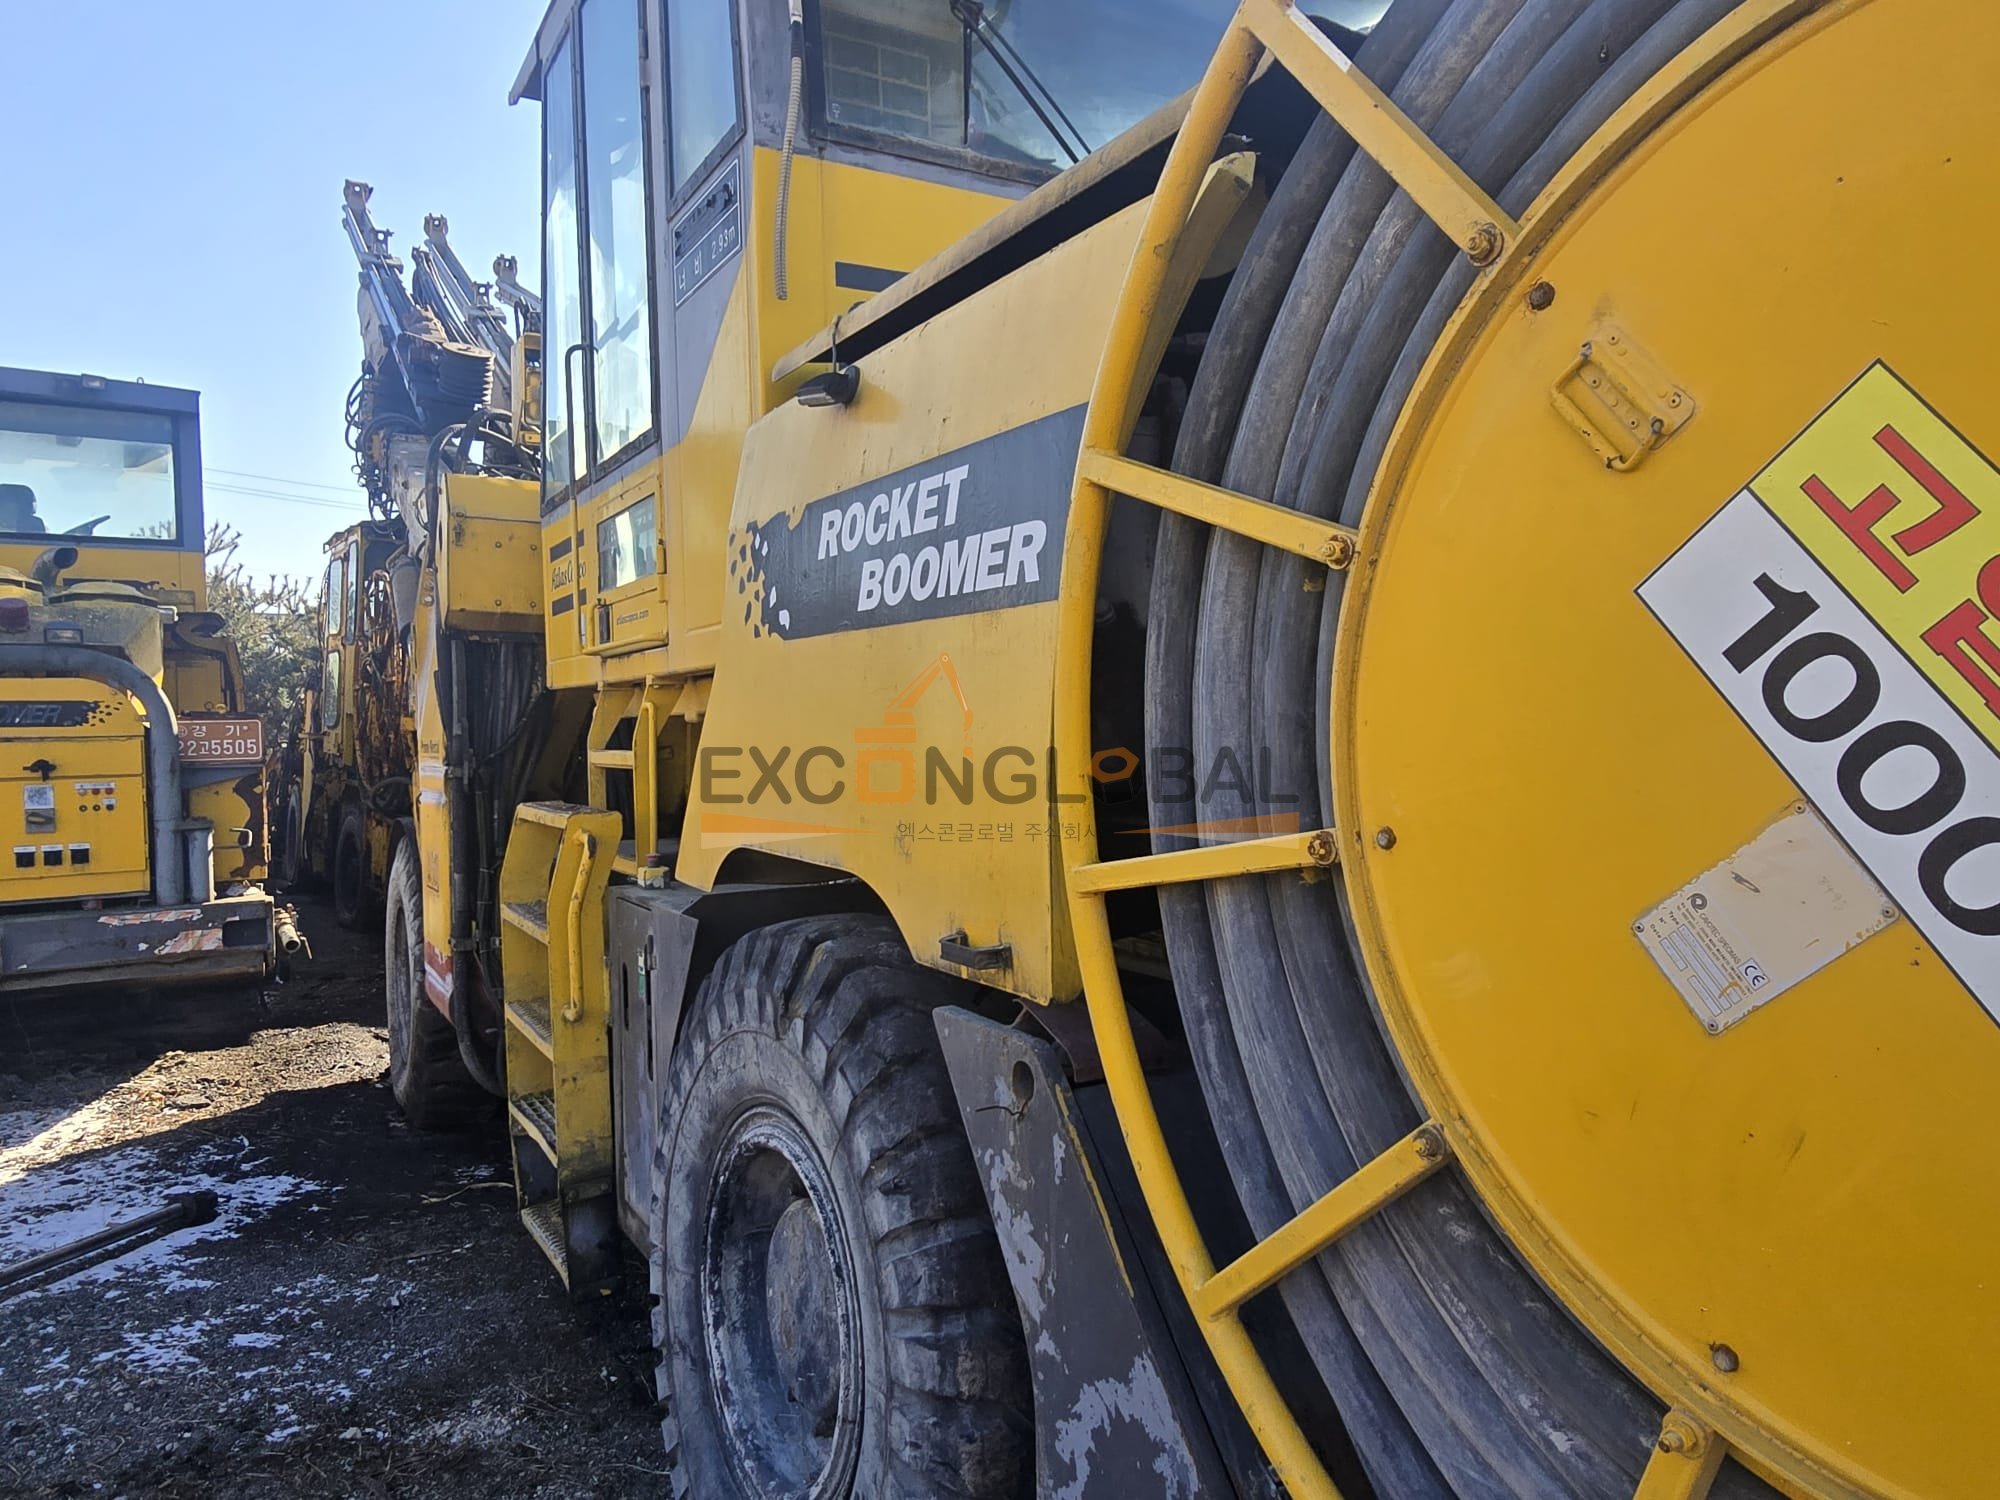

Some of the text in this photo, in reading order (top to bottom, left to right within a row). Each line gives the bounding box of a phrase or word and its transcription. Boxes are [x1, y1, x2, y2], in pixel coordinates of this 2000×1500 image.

[711, 226, 736, 260] 2.93m
[818, 464, 969, 560] ROCKET
[857, 520, 1047, 612] BOOMER
[178, 739, 257, 756] 22고5505
[1722, 572, 2000, 936] 1000
[1744, 965, 1766, 987] CE
